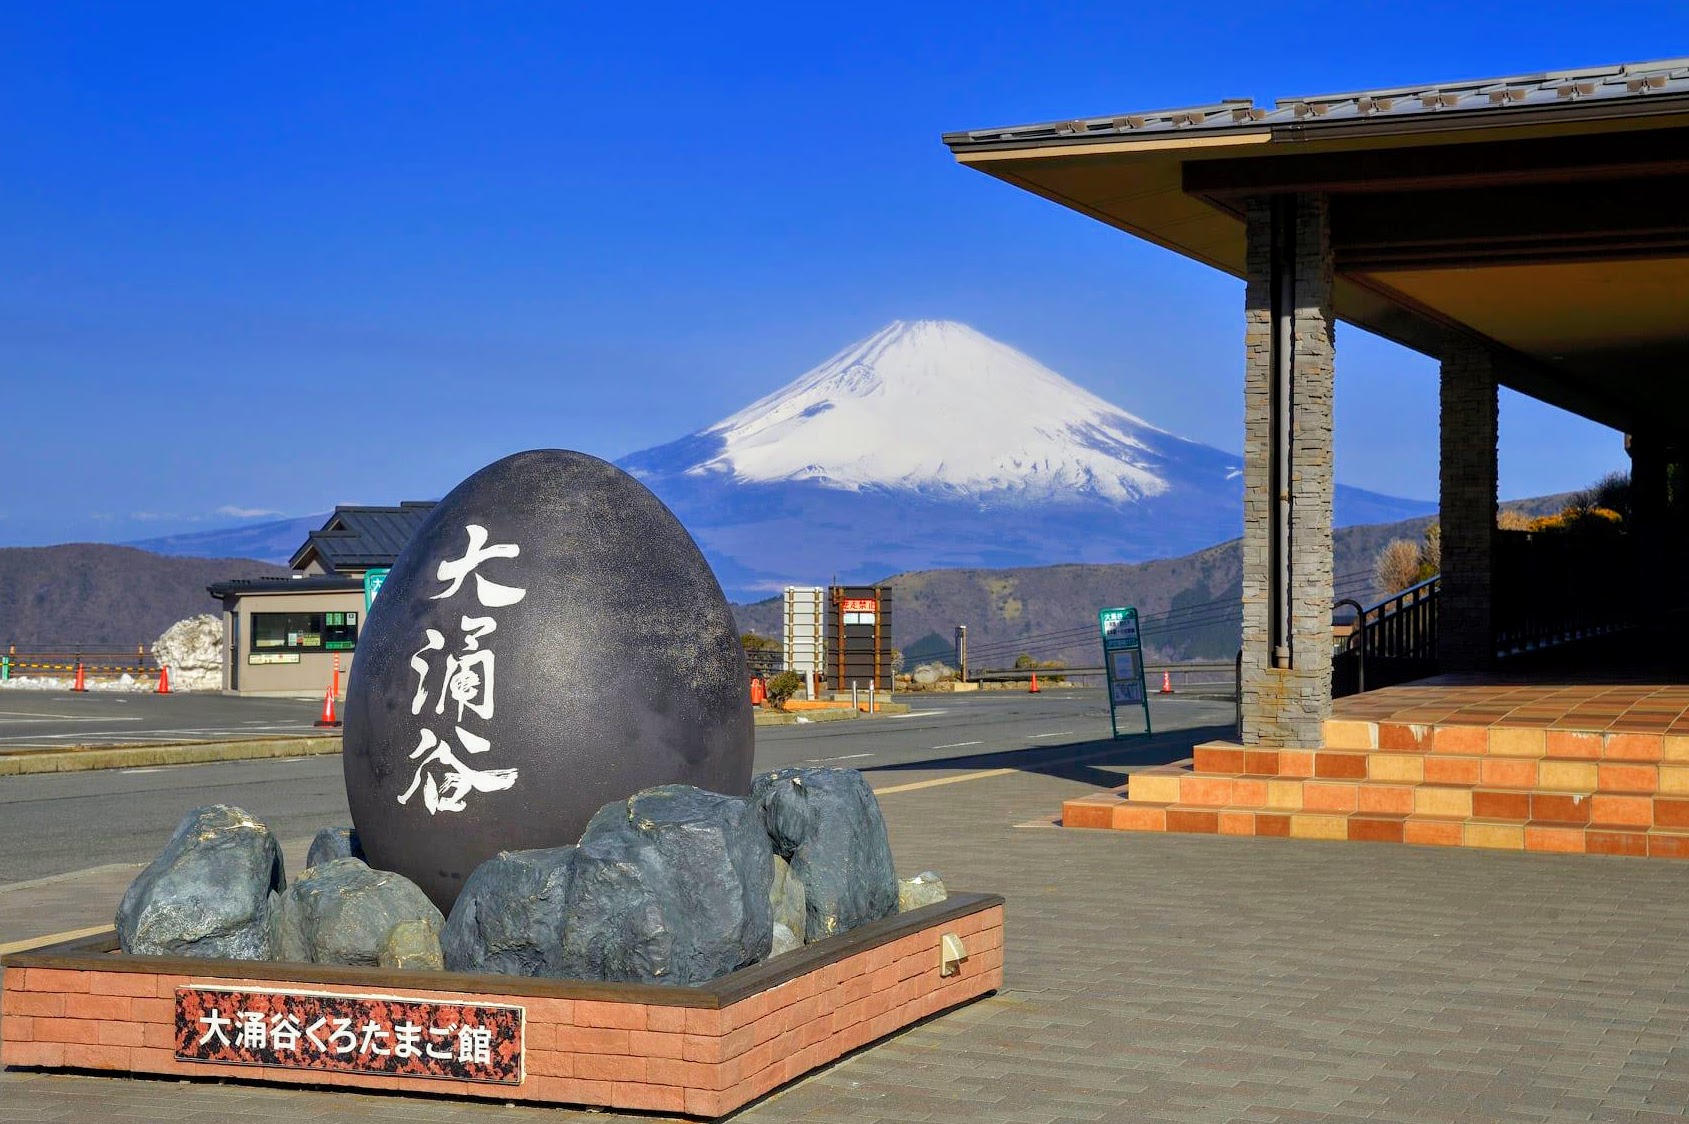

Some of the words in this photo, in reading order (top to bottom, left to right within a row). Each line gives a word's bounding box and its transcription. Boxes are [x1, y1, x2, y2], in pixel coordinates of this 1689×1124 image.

[397, 525, 526, 815] 大涌谷
[199, 1008, 492, 1065] 大涌谷くろたまご館
